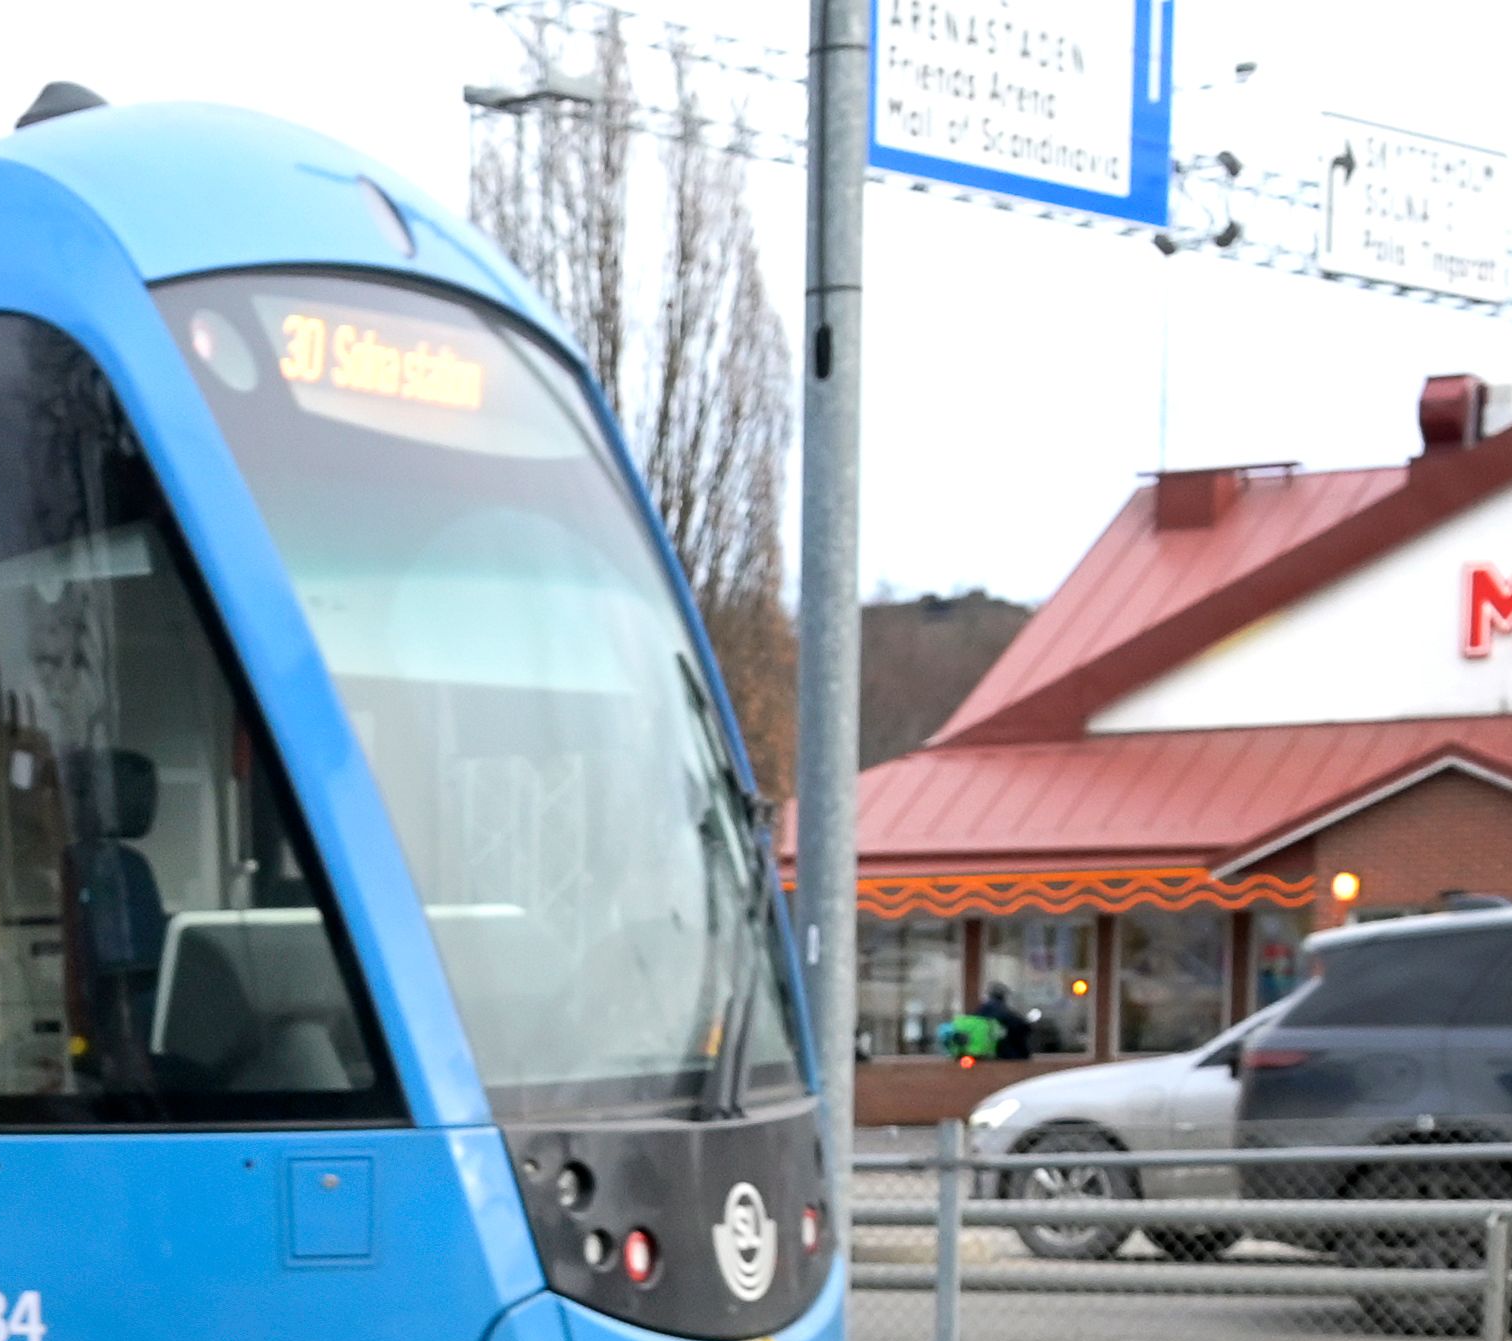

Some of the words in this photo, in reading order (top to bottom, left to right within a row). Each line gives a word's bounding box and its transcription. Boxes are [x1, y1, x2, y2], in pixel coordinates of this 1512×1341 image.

[888, 0, 1085, 75] ARENASTADEN
[887, 44, 977, 101] Friends
[988, 71, 1058, 120] Arena
[947, 116, 970, 146] of
[980, 116, 1121, 181] Scandinavia
[279, 313, 326, 384] 30
